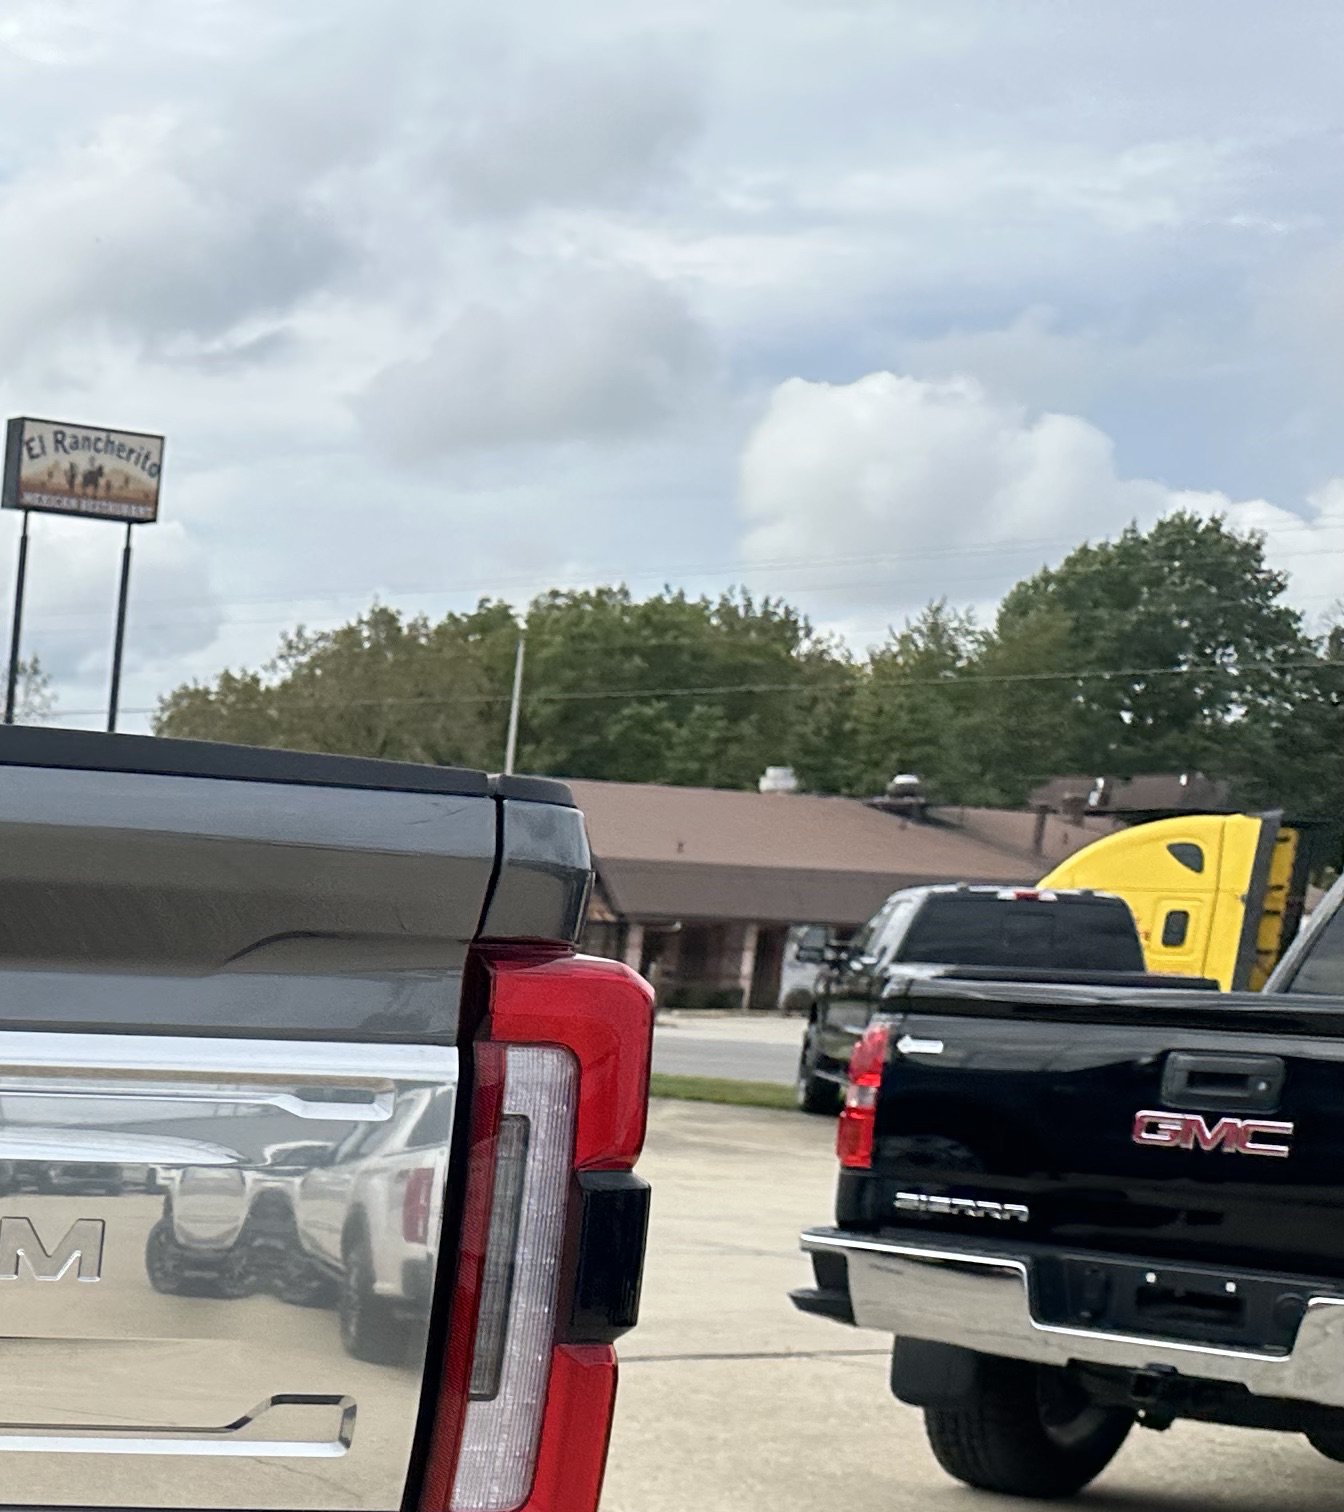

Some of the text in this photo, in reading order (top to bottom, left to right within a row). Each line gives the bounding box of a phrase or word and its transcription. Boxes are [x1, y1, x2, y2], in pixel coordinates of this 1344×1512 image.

[25, 434, 48, 460] El
[1132, 1109, 1295, 1159] GMC
[894, 1191, 1029, 1223] SIERRA
